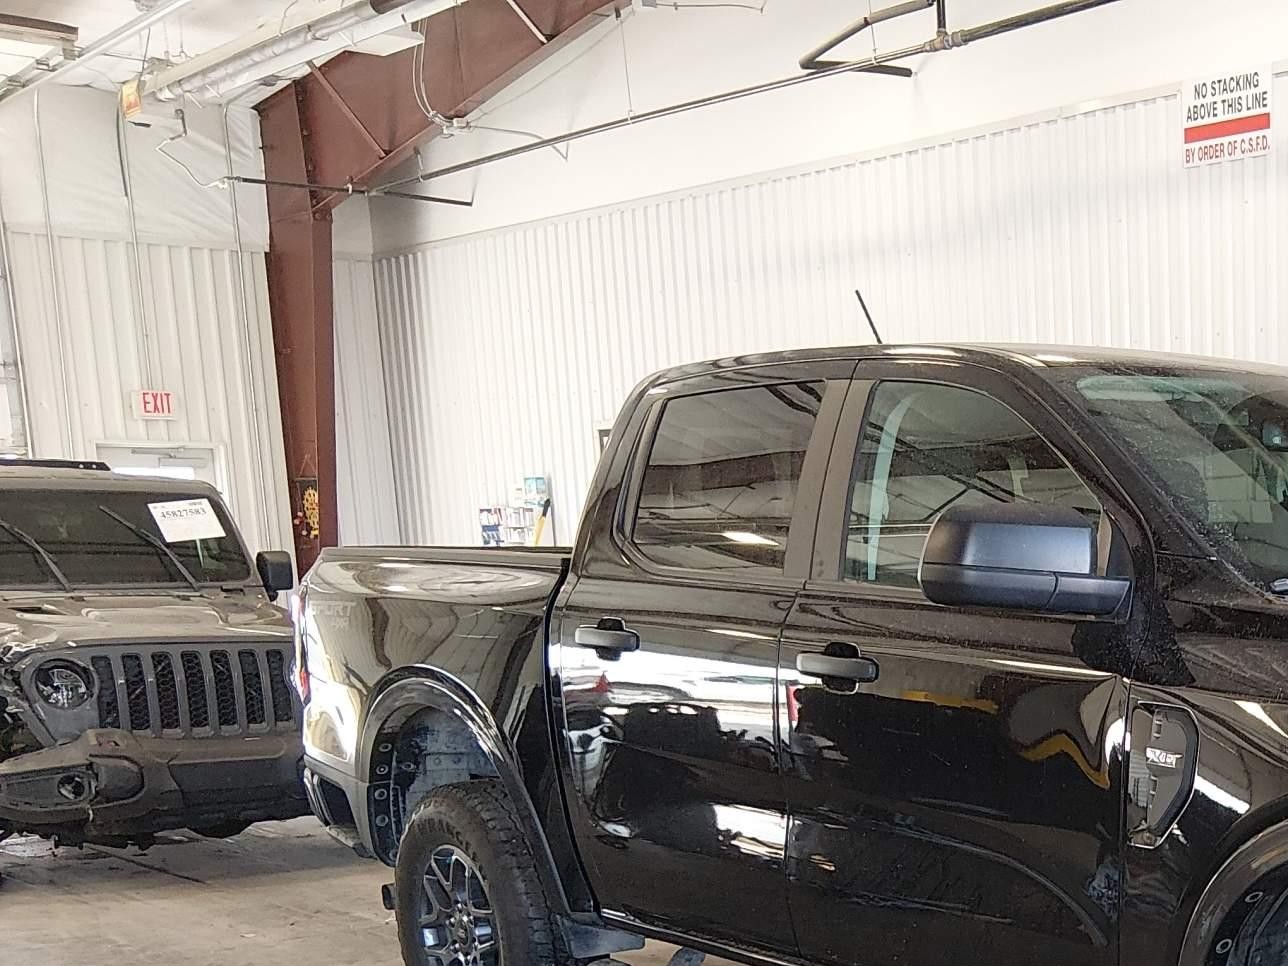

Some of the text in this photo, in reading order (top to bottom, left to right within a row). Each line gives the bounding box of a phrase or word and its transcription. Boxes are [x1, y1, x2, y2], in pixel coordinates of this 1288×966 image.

[1194, 72, 1259, 100] NO STACKING
[1187, 91, 1268, 122] ABOVE THIS LINE
[1185, 135, 1270, 164] BY ORDER OF C.S.F.D.
[142, 391, 171, 414] EXIT
